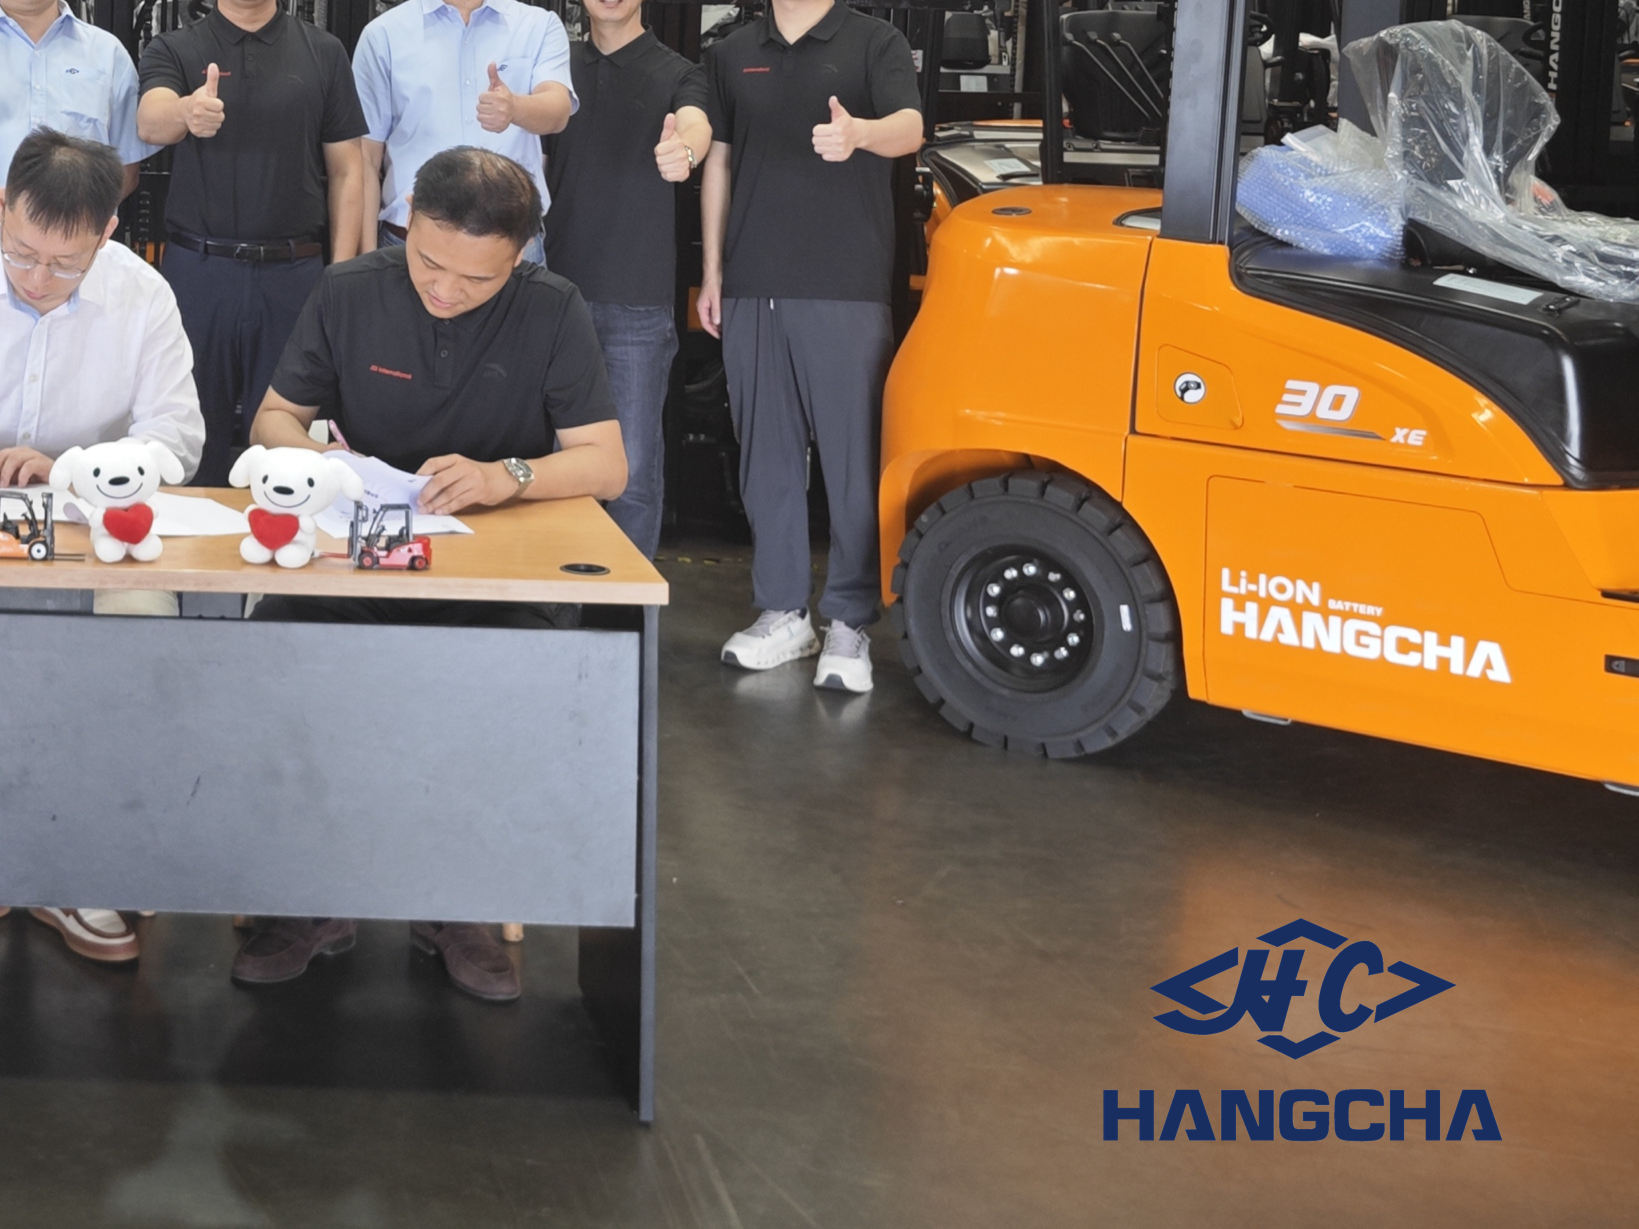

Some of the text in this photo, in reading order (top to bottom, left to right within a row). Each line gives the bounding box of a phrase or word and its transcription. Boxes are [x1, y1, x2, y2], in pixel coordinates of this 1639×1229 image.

[1274, 379, 1360, 422] 30
[1389, 427, 1428, 447] XE
[1221, 567, 1384, 617] Li-ION BATTERY
[1220, 597, 1512, 684] HANGCHA
